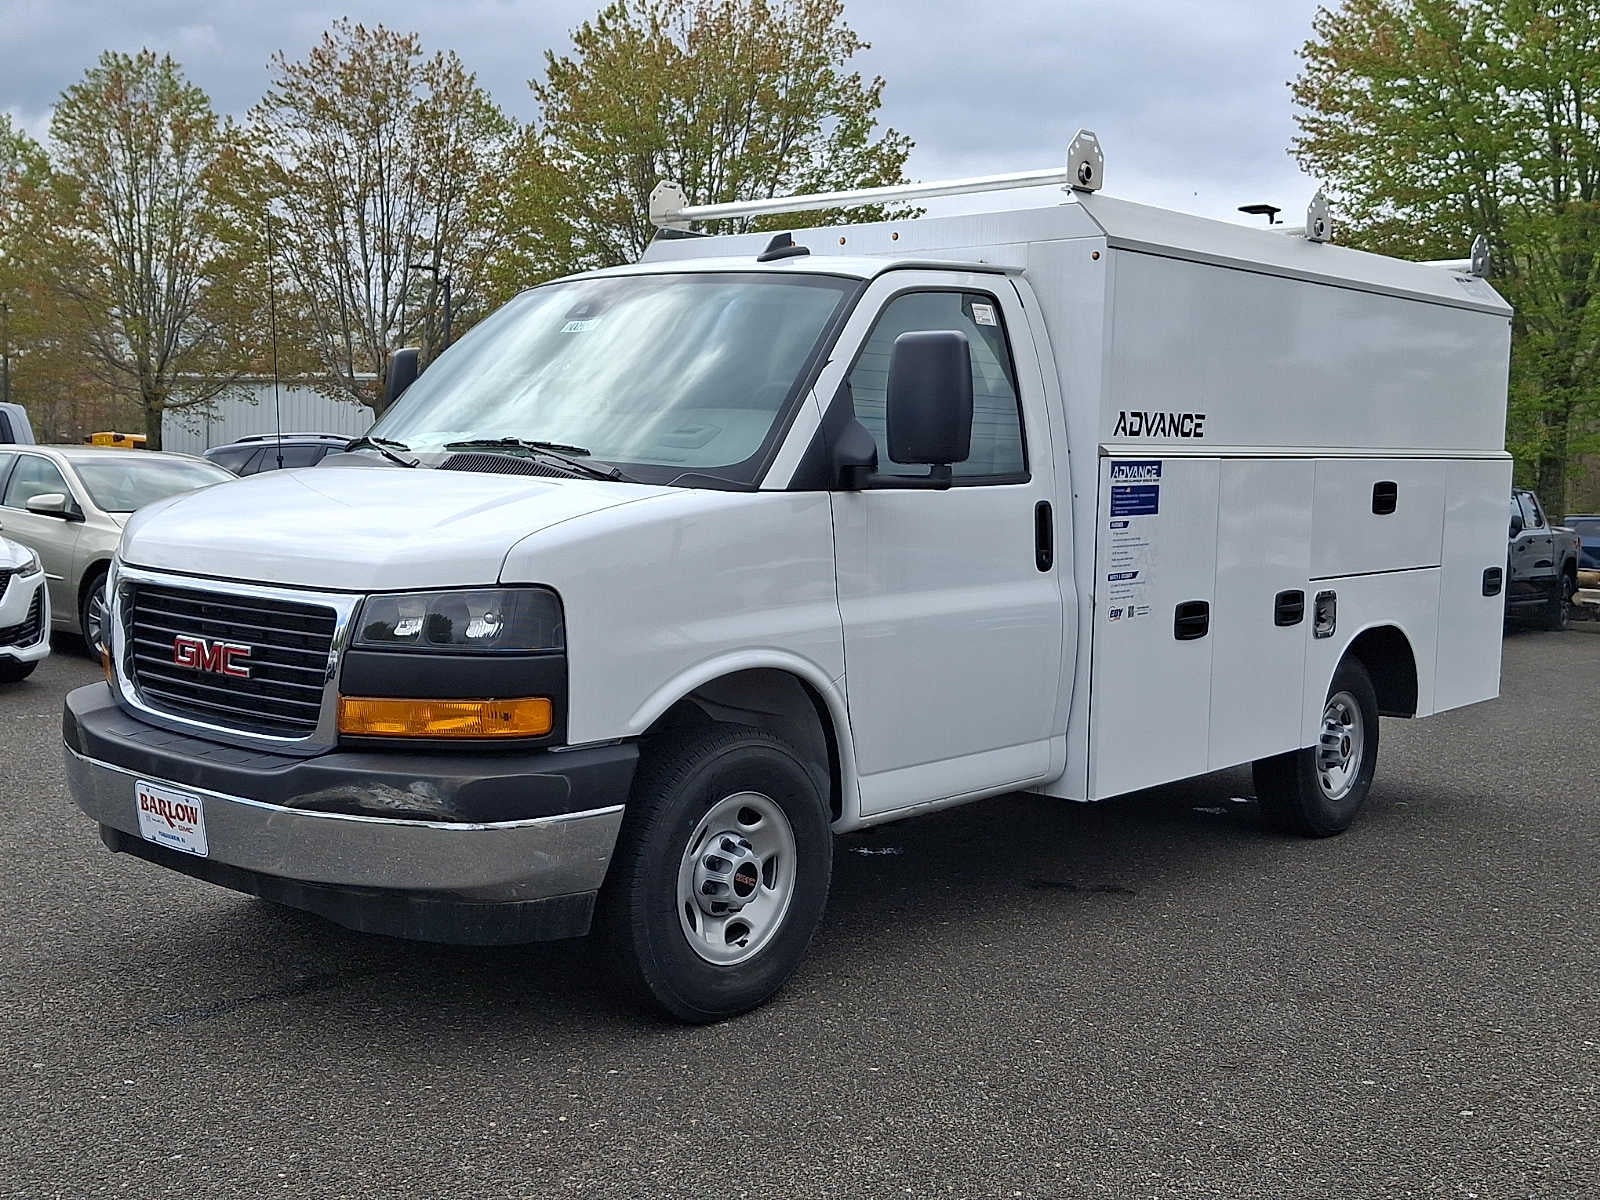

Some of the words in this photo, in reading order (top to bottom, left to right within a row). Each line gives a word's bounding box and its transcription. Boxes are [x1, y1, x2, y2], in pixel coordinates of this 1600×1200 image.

[1113, 411, 1206, 438] ADVANCE
[1112, 465, 1159, 479] ADVANCE
[175, 634, 252, 678] GMC
[139, 793, 198, 830] BARLOW
